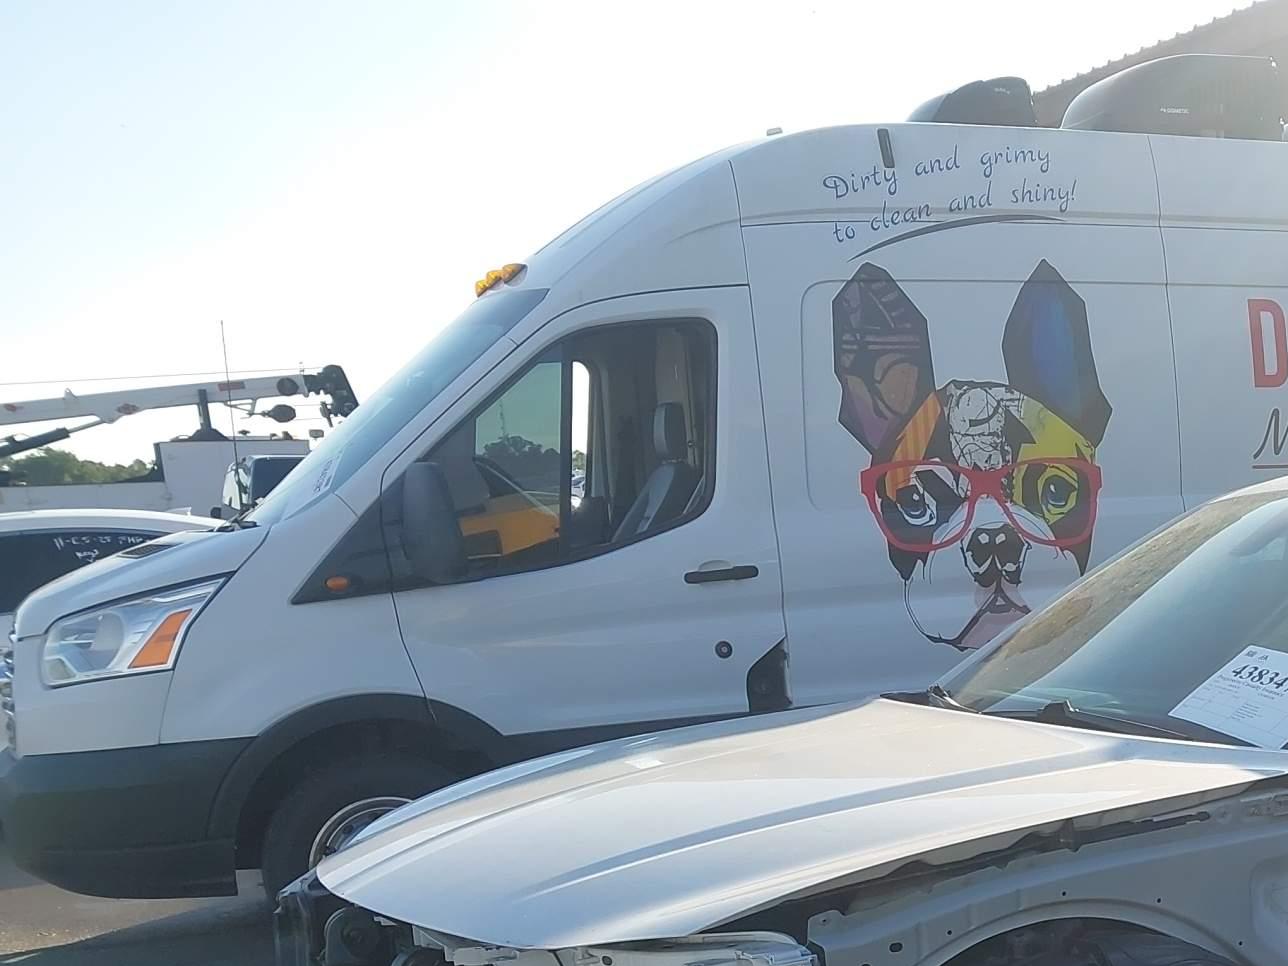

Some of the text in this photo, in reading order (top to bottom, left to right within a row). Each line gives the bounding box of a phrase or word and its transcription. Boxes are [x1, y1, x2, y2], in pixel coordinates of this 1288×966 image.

[823, 145, 1051, 198] Dirty and grimy
[832, 179, 1078, 243] to clean and shiny!
